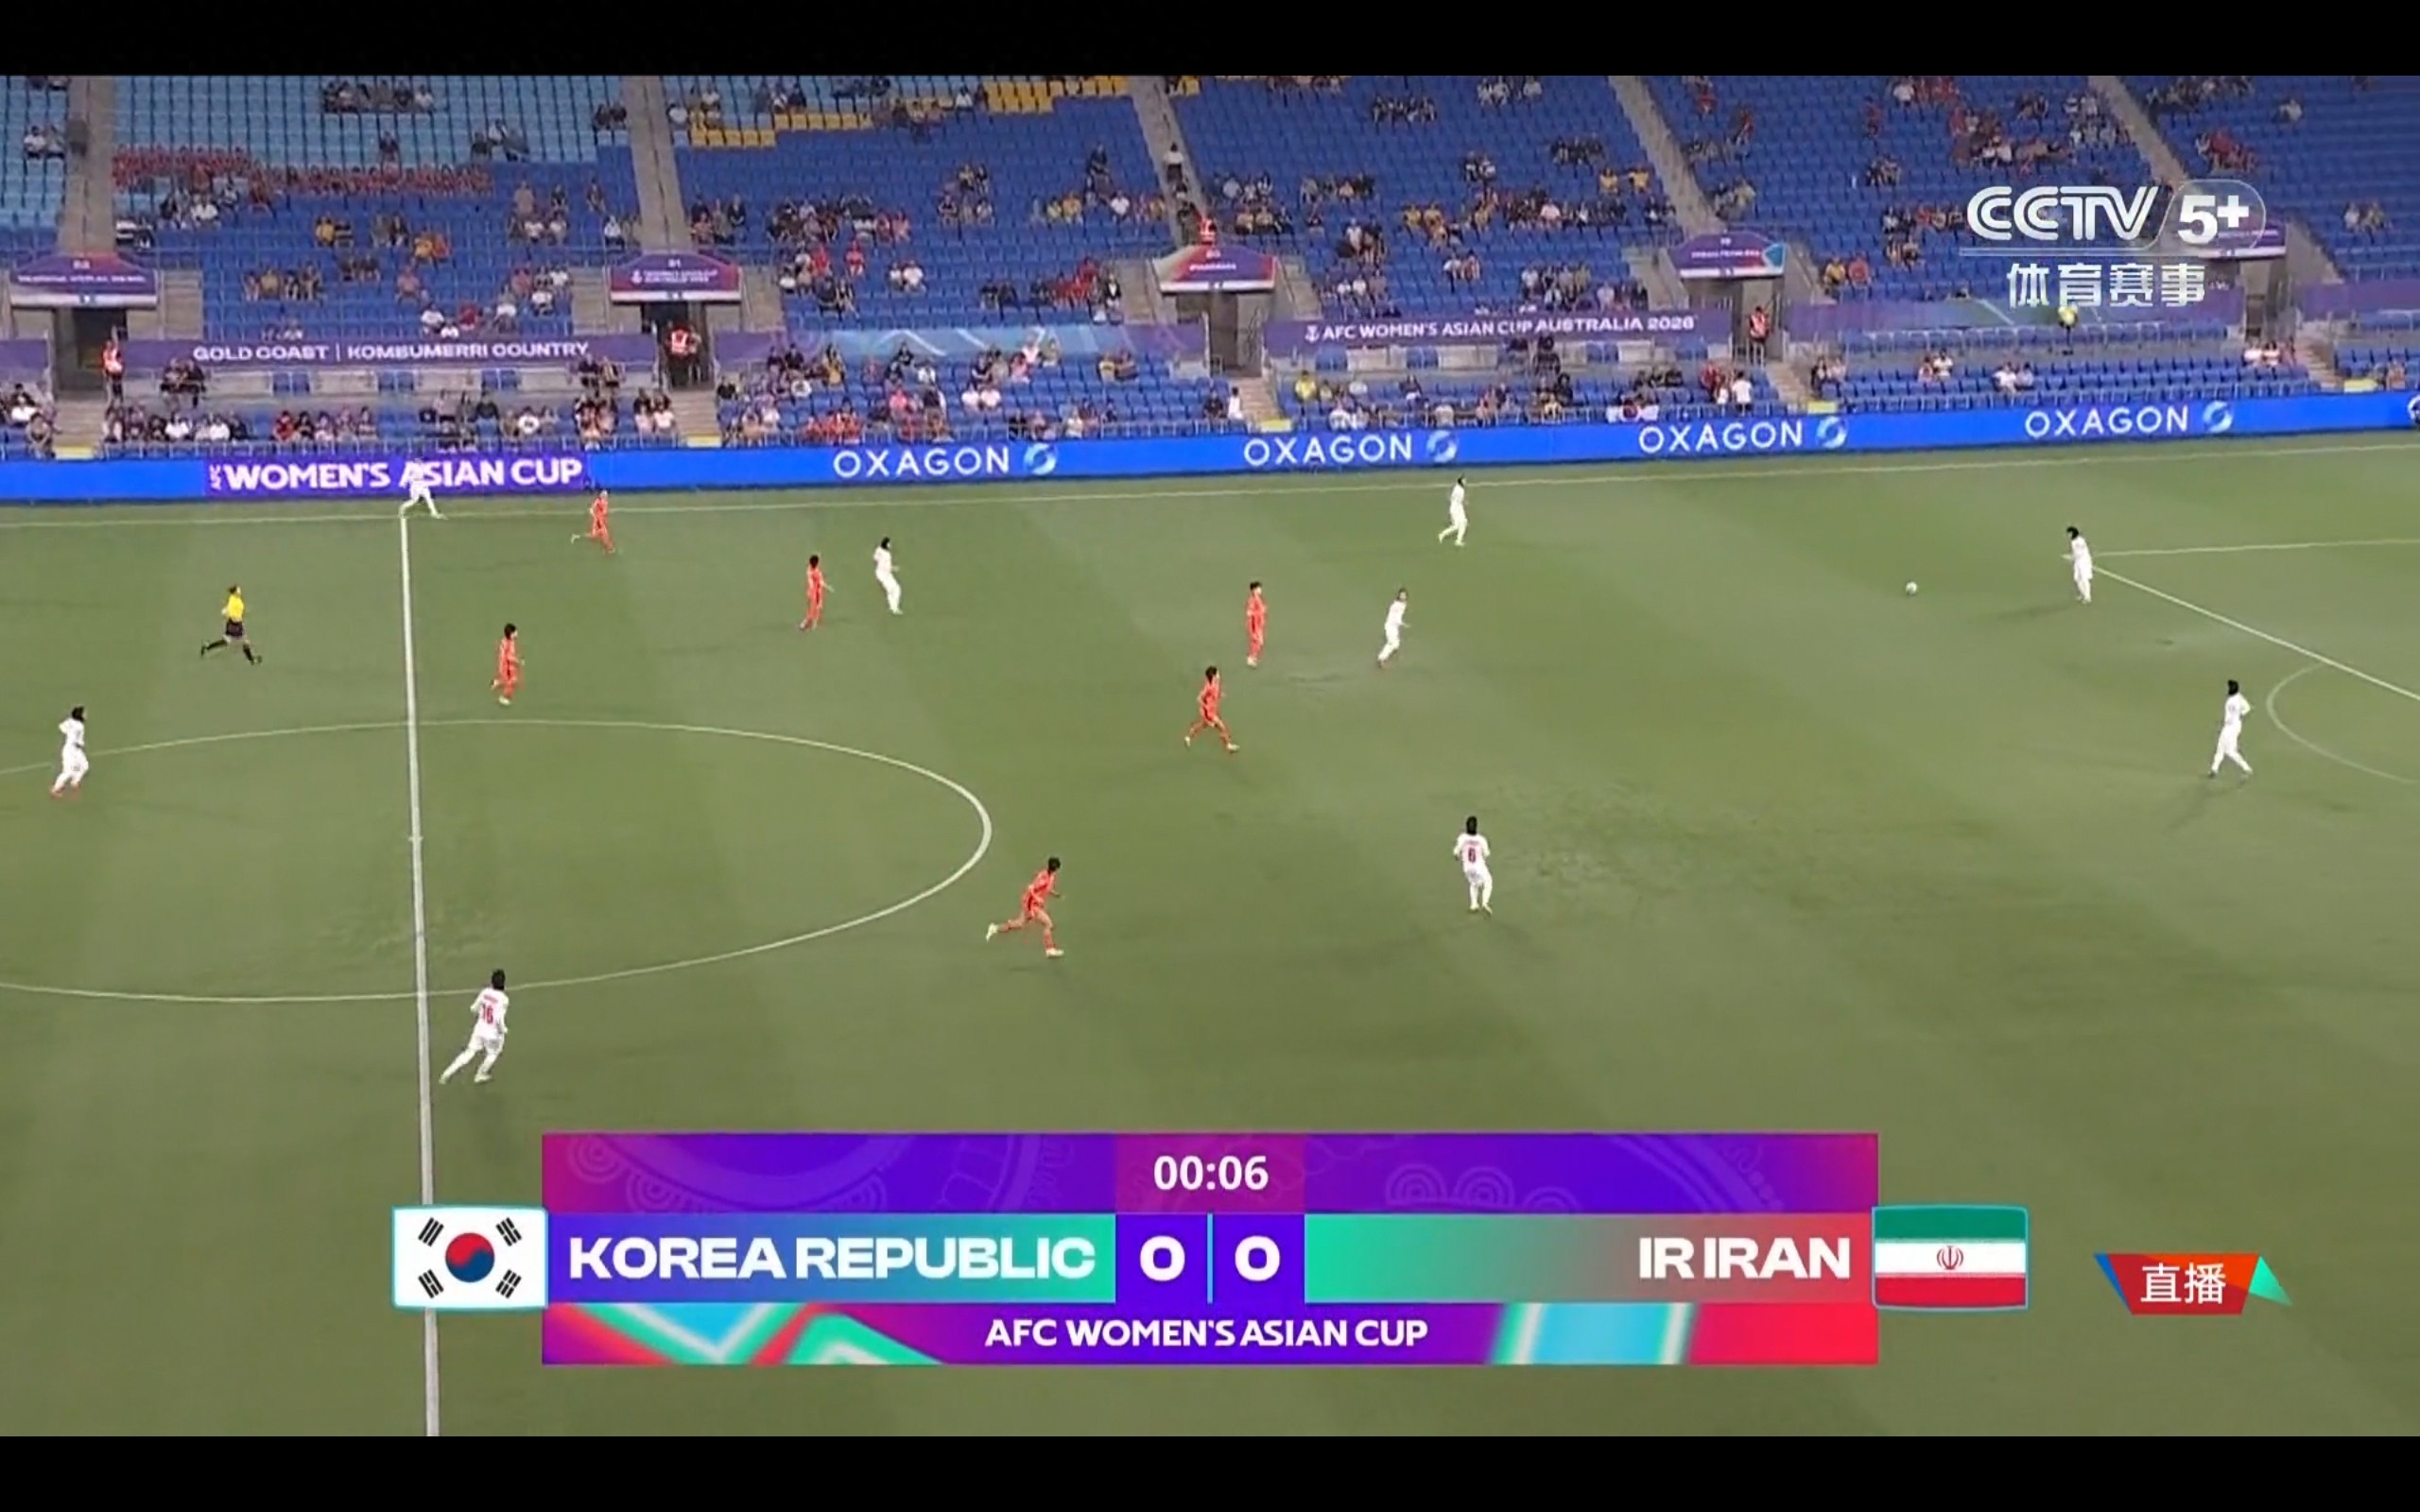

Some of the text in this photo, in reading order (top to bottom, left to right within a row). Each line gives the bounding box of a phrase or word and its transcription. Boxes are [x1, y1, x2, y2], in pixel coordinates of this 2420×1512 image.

[1322, 315, 1696, 341] AFC WOMEN'S ASIAN CUP AUSTRALIA 2026
[193, 341, 590, 362] GOLD COAST KOMBUMERRI COUNTRY
[1638, 420, 1802, 454] OXAGON
[2025, 404, 2189, 438] OXAGON
[833, 445, 1010, 478] OXAGON
[1243, 433, 1412, 467] OXAGON
[222, 462, 391, 490] WOMEN'S
[510, 456, 582, 485] CUP
